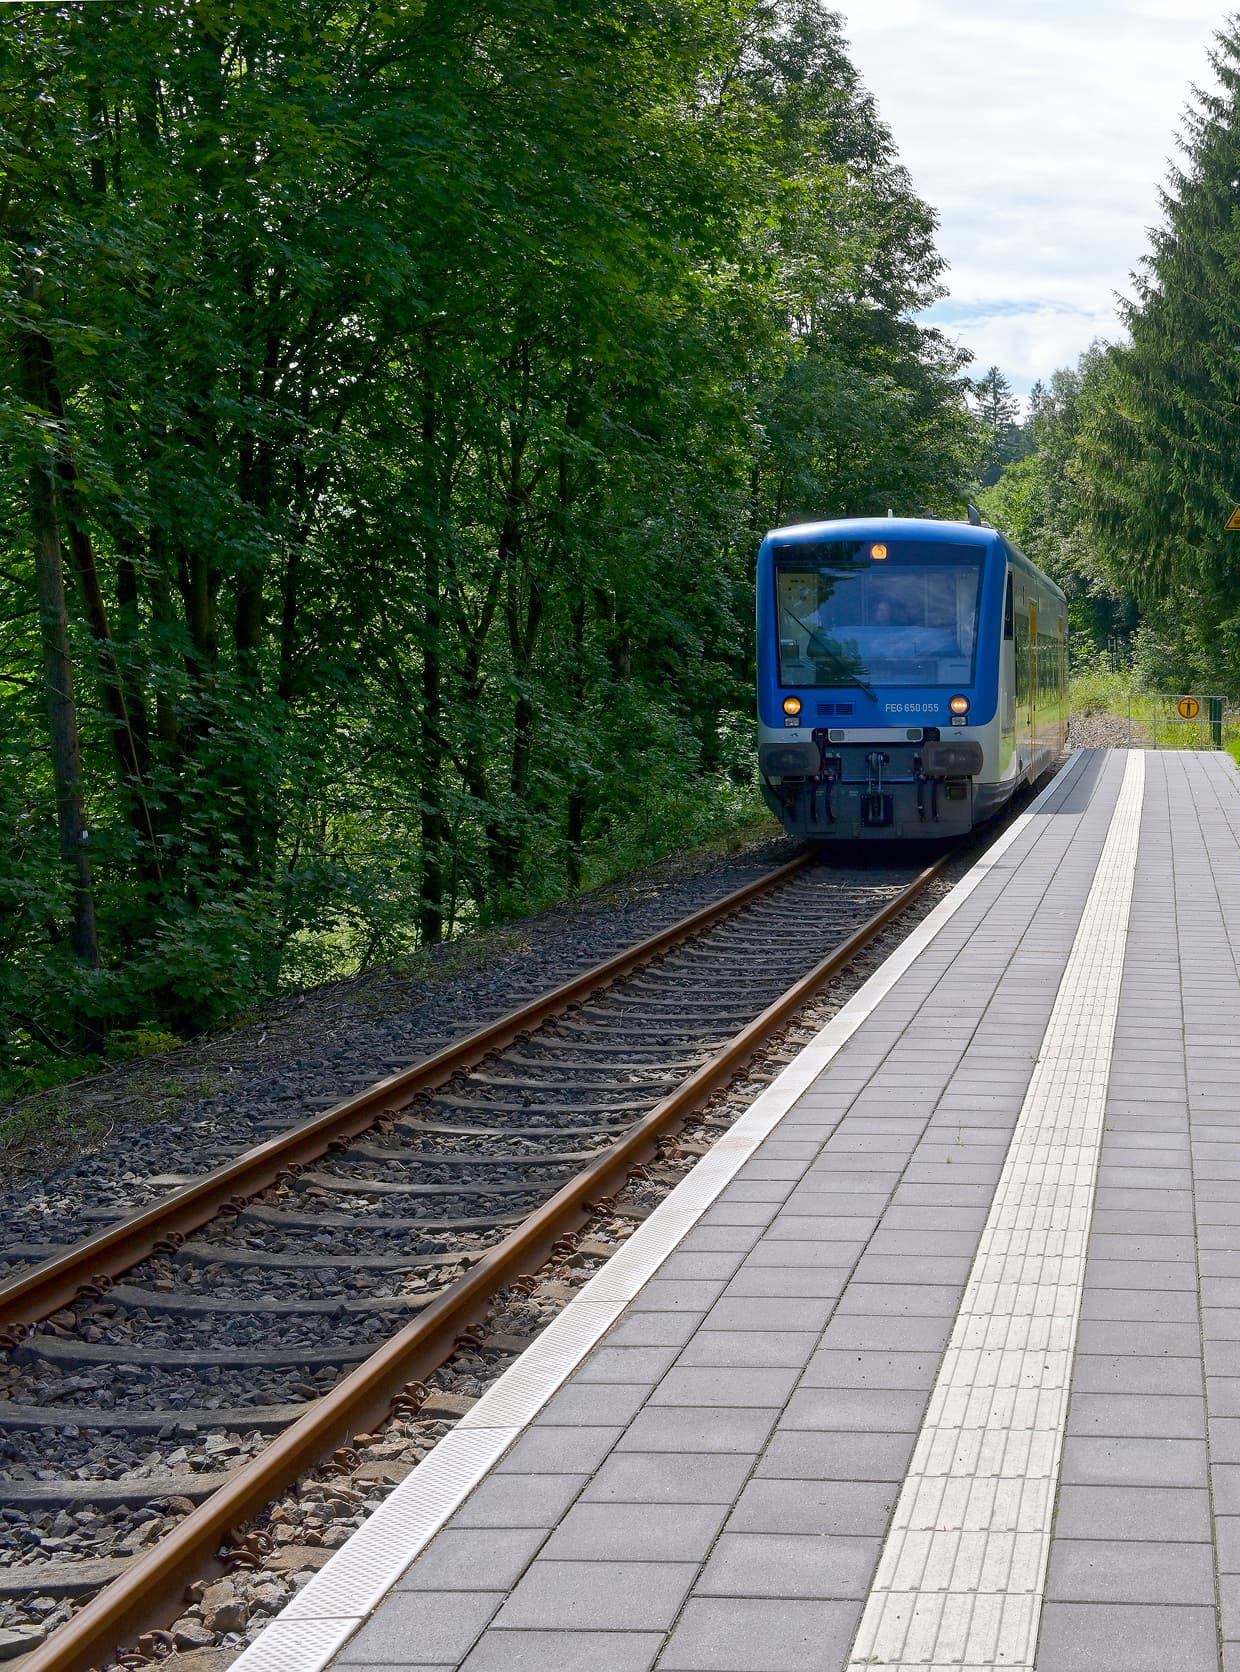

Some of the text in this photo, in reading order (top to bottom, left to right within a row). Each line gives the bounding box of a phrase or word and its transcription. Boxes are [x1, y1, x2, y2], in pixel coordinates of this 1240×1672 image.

[885, 703, 939, 713] FEG 650 055
